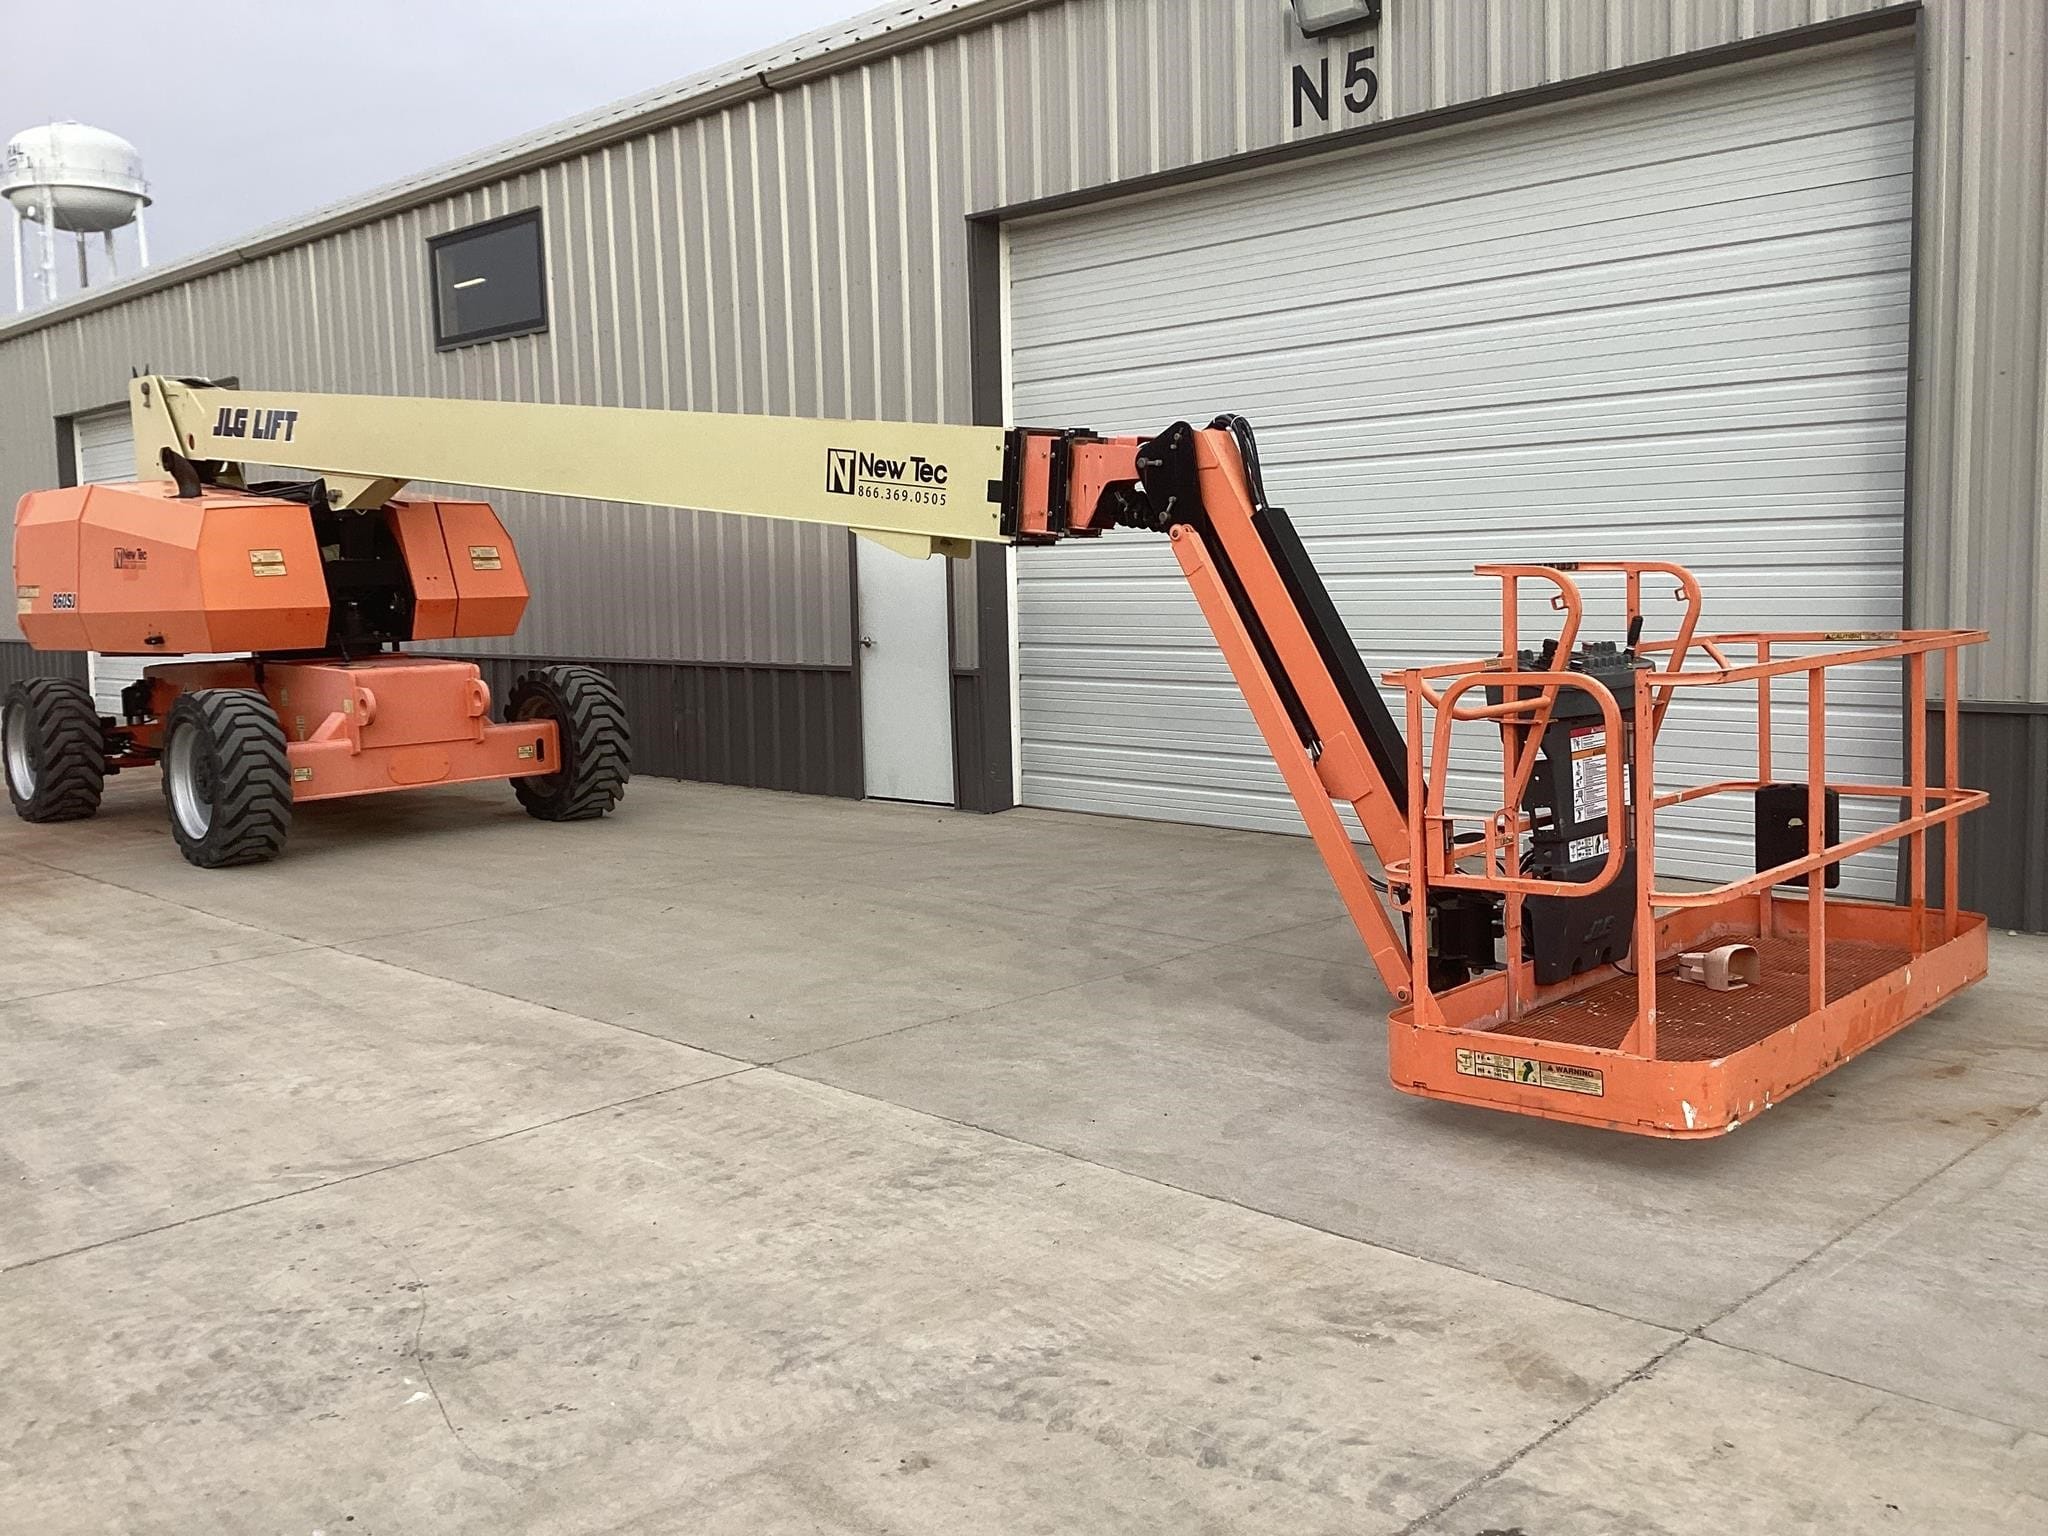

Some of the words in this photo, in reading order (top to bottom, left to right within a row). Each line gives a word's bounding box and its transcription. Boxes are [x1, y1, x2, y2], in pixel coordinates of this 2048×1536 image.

[213, 407, 249, 438] JLG
[252, 409, 299, 442] LIFT
[858, 451, 907, 480] New
[910, 456, 948, 484] Tec
[858, 485, 947, 506] 866.369.0505
[1555, 1065, 1594, 1078] WARNING
